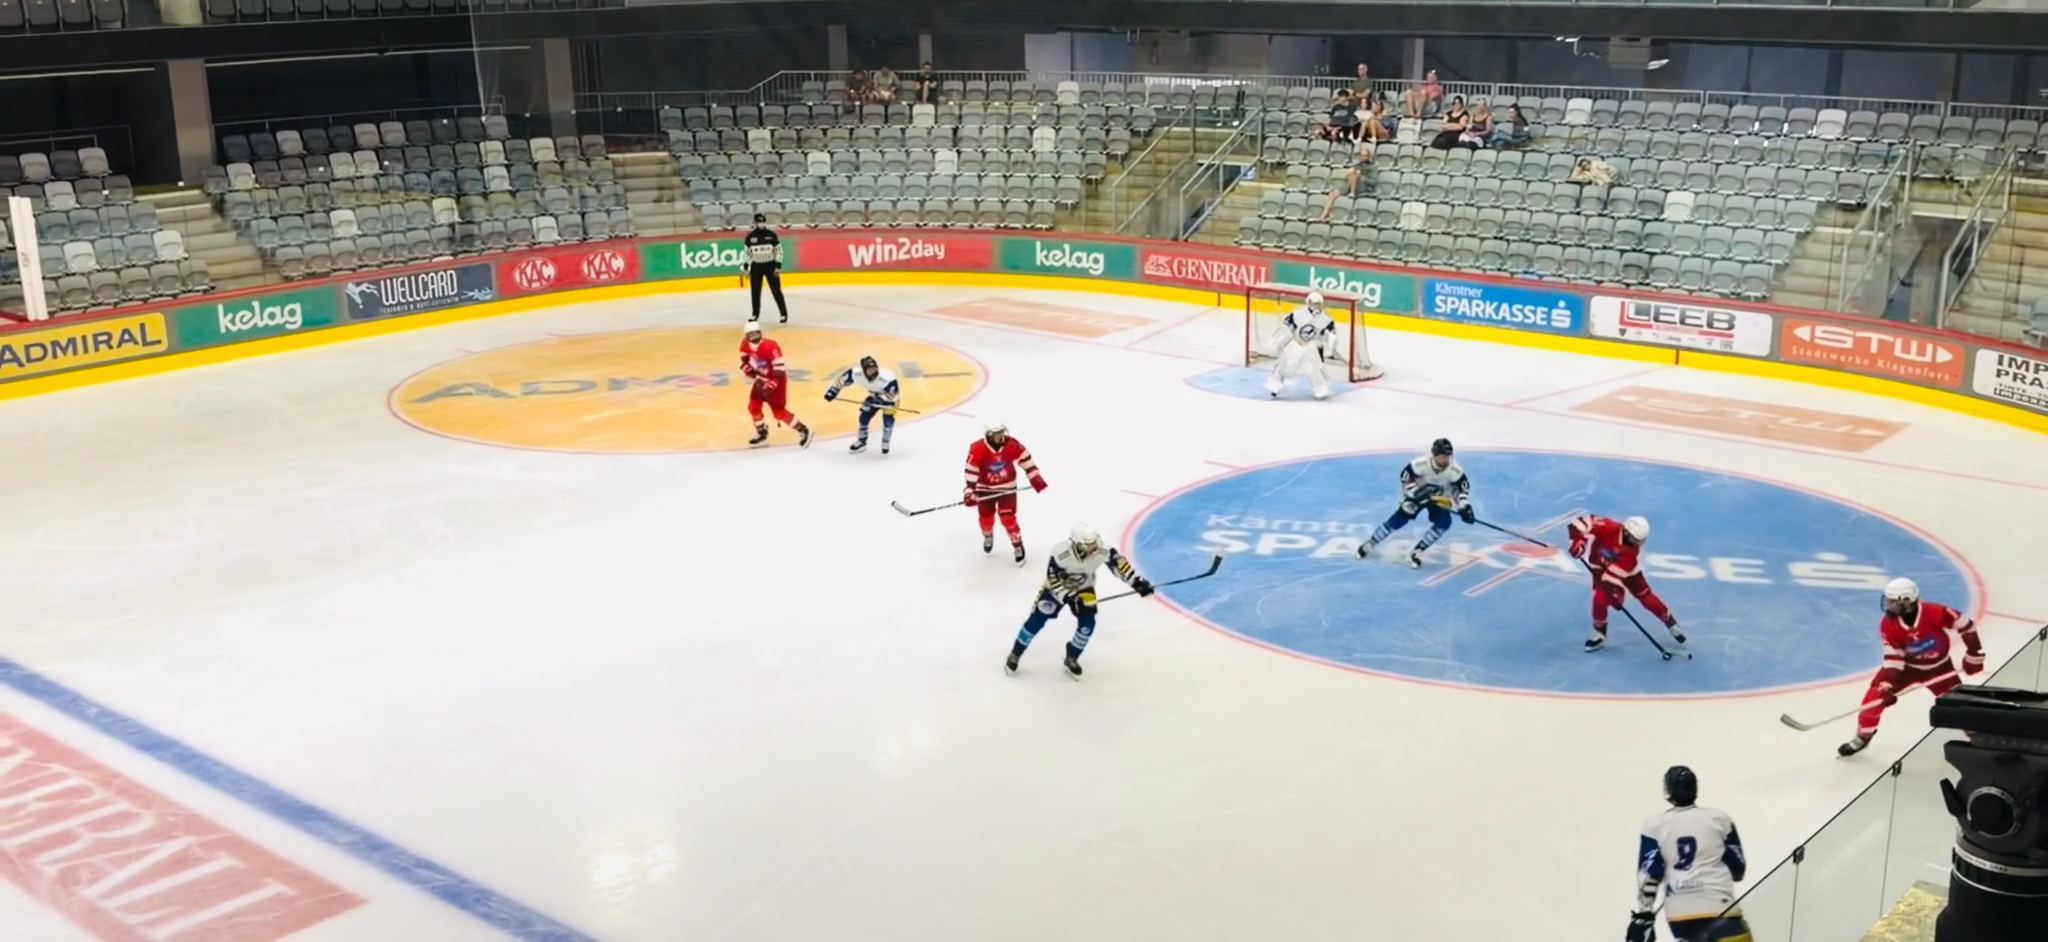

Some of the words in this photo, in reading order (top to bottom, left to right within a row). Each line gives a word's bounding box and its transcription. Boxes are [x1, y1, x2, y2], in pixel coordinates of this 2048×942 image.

[586, 252, 623, 280] KAC
[848, 237, 945, 267] win2day
[1035, 241, 1104, 275] kelag
[517, 260, 552, 288] KAC
[1172, 257, 1268, 285] GENERALI
[380, 269, 458, 306] WELLCARD
[1309, 266, 1382, 308] kelag
[1435, 282, 1483, 298] Kärntner
[218, 301, 302, 334] kelag
[1434, 295, 1549, 325] SPARKASSE
[1626, 301, 1736, 331] LEEB
[0, 322, 162, 369] ADMIRAL
[1814, 325, 1933, 363] STW
[1791, 345, 1870, 366] Stadtwerke
[1876, 358, 1950, 381] Klagenfurt
[1996, 368, 2048, 389] PRA
[1206, 513, 1376, 535] Kärntn
